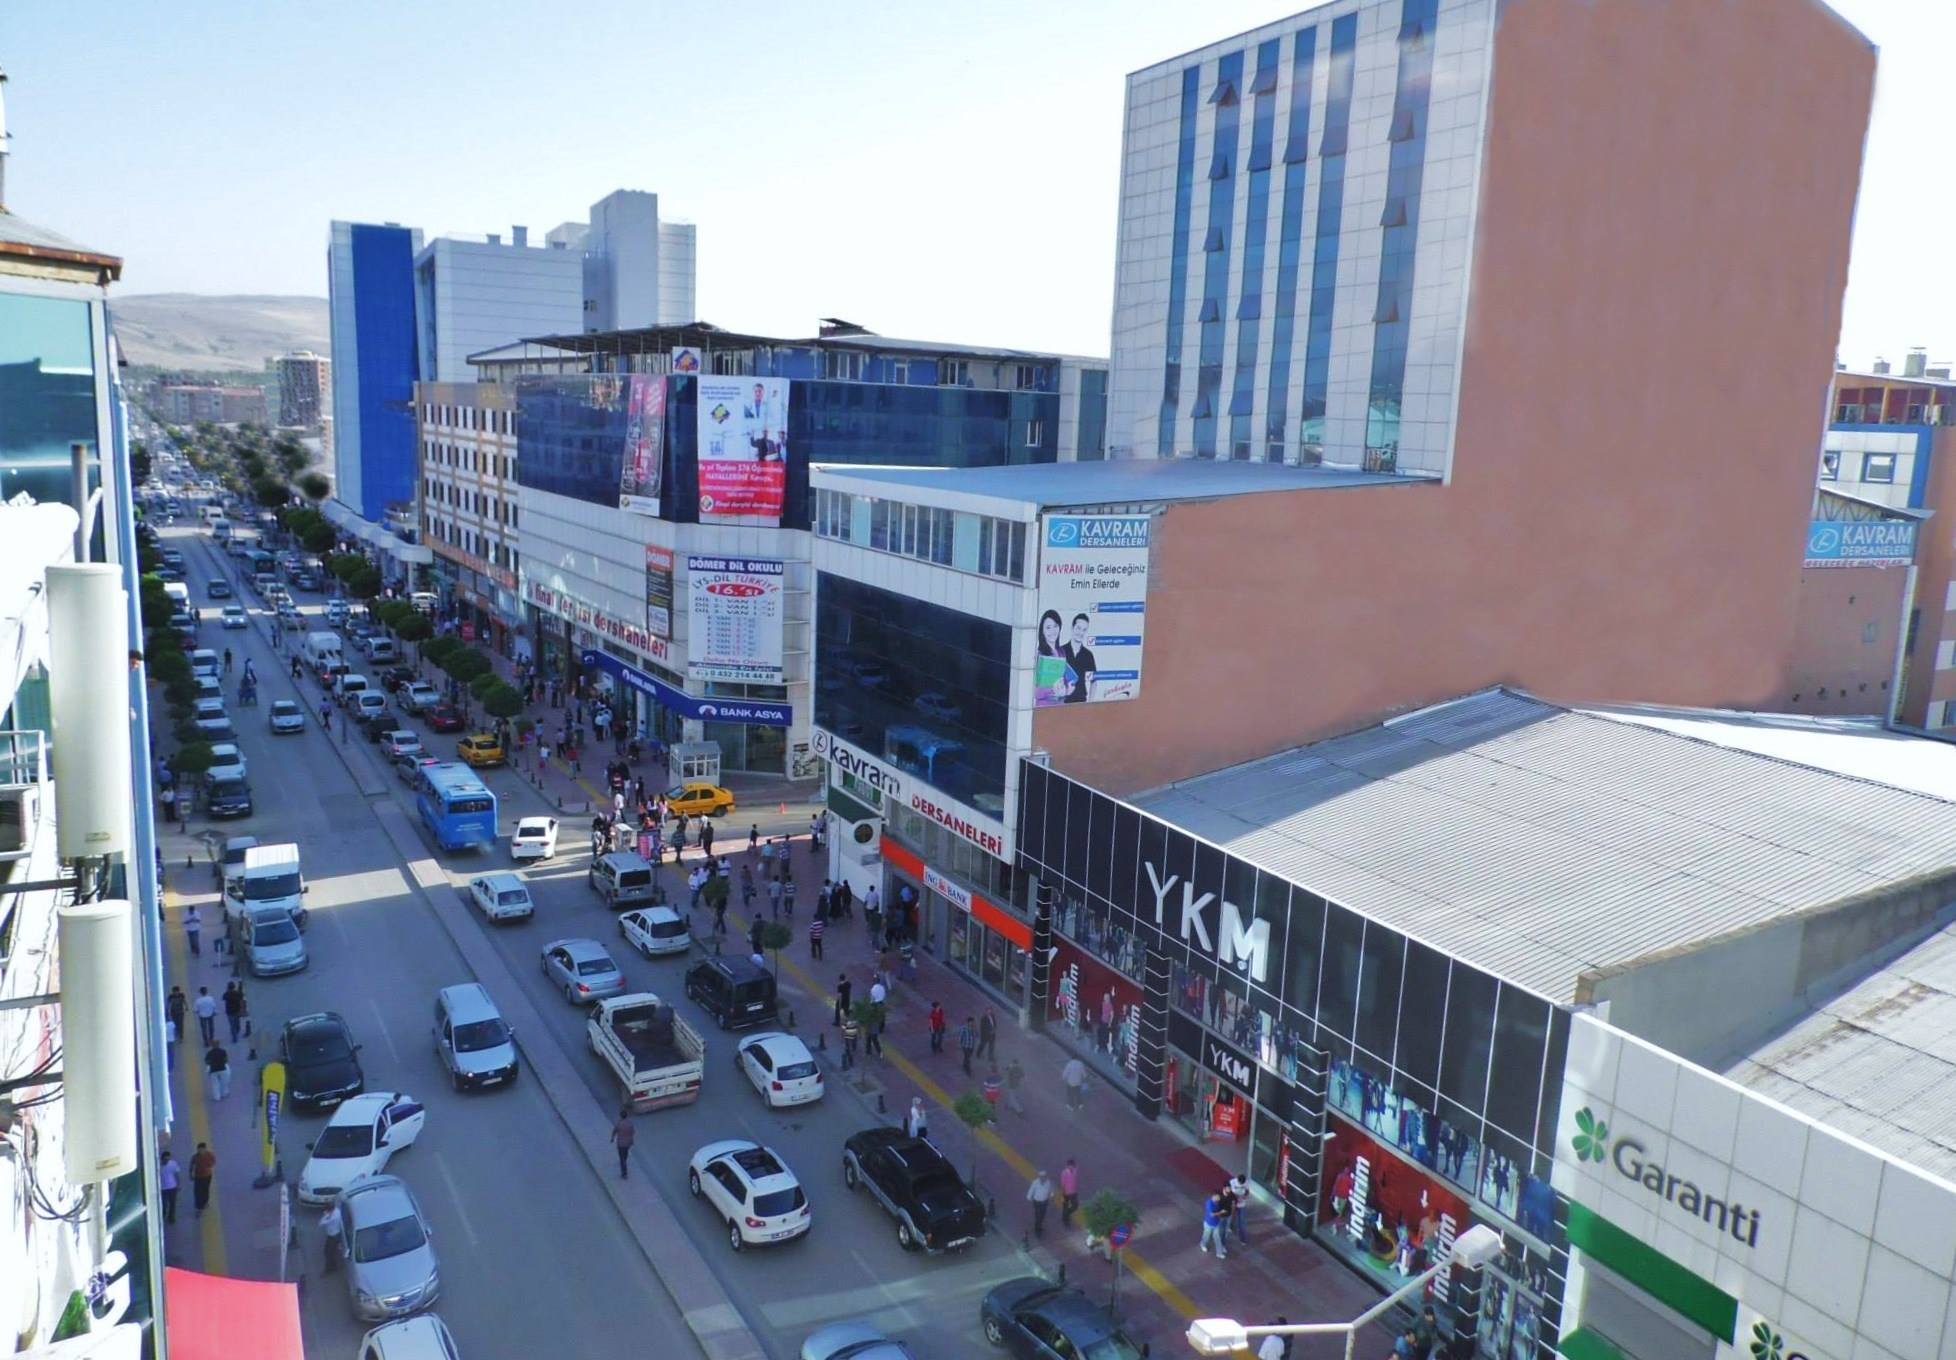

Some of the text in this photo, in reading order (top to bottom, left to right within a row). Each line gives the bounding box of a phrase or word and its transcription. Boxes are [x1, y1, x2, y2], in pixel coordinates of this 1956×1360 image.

[1081, 521, 1147, 537] KAVRAM
[1841, 525, 1913, 544] KAVRAM
[689, 558, 783, 573] DÖMER DİL OKULU
[1046, 563, 1145, 576] KAVRAM ile Geleceğiniz
[1070, 578, 1120, 589] Emin Ellerde
[593, 609, 668, 660] dershaneleri
[720, 707, 784, 720] BANK ASYA
[829, 736, 1004, 856] kavram DERSANELERİ
[925, 871, 968, 906] ING BANK
[1145, 861, 1270, 983] YKM
[1065, 962, 1079, 1027] indirim
[1124, 1004, 1141, 1073] indirim
[1210, 1043, 1249, 1087] YKM
[1345, 1154, 1371, 1241] indirim
[1612, 1137, 1761, 1249] Garanti
